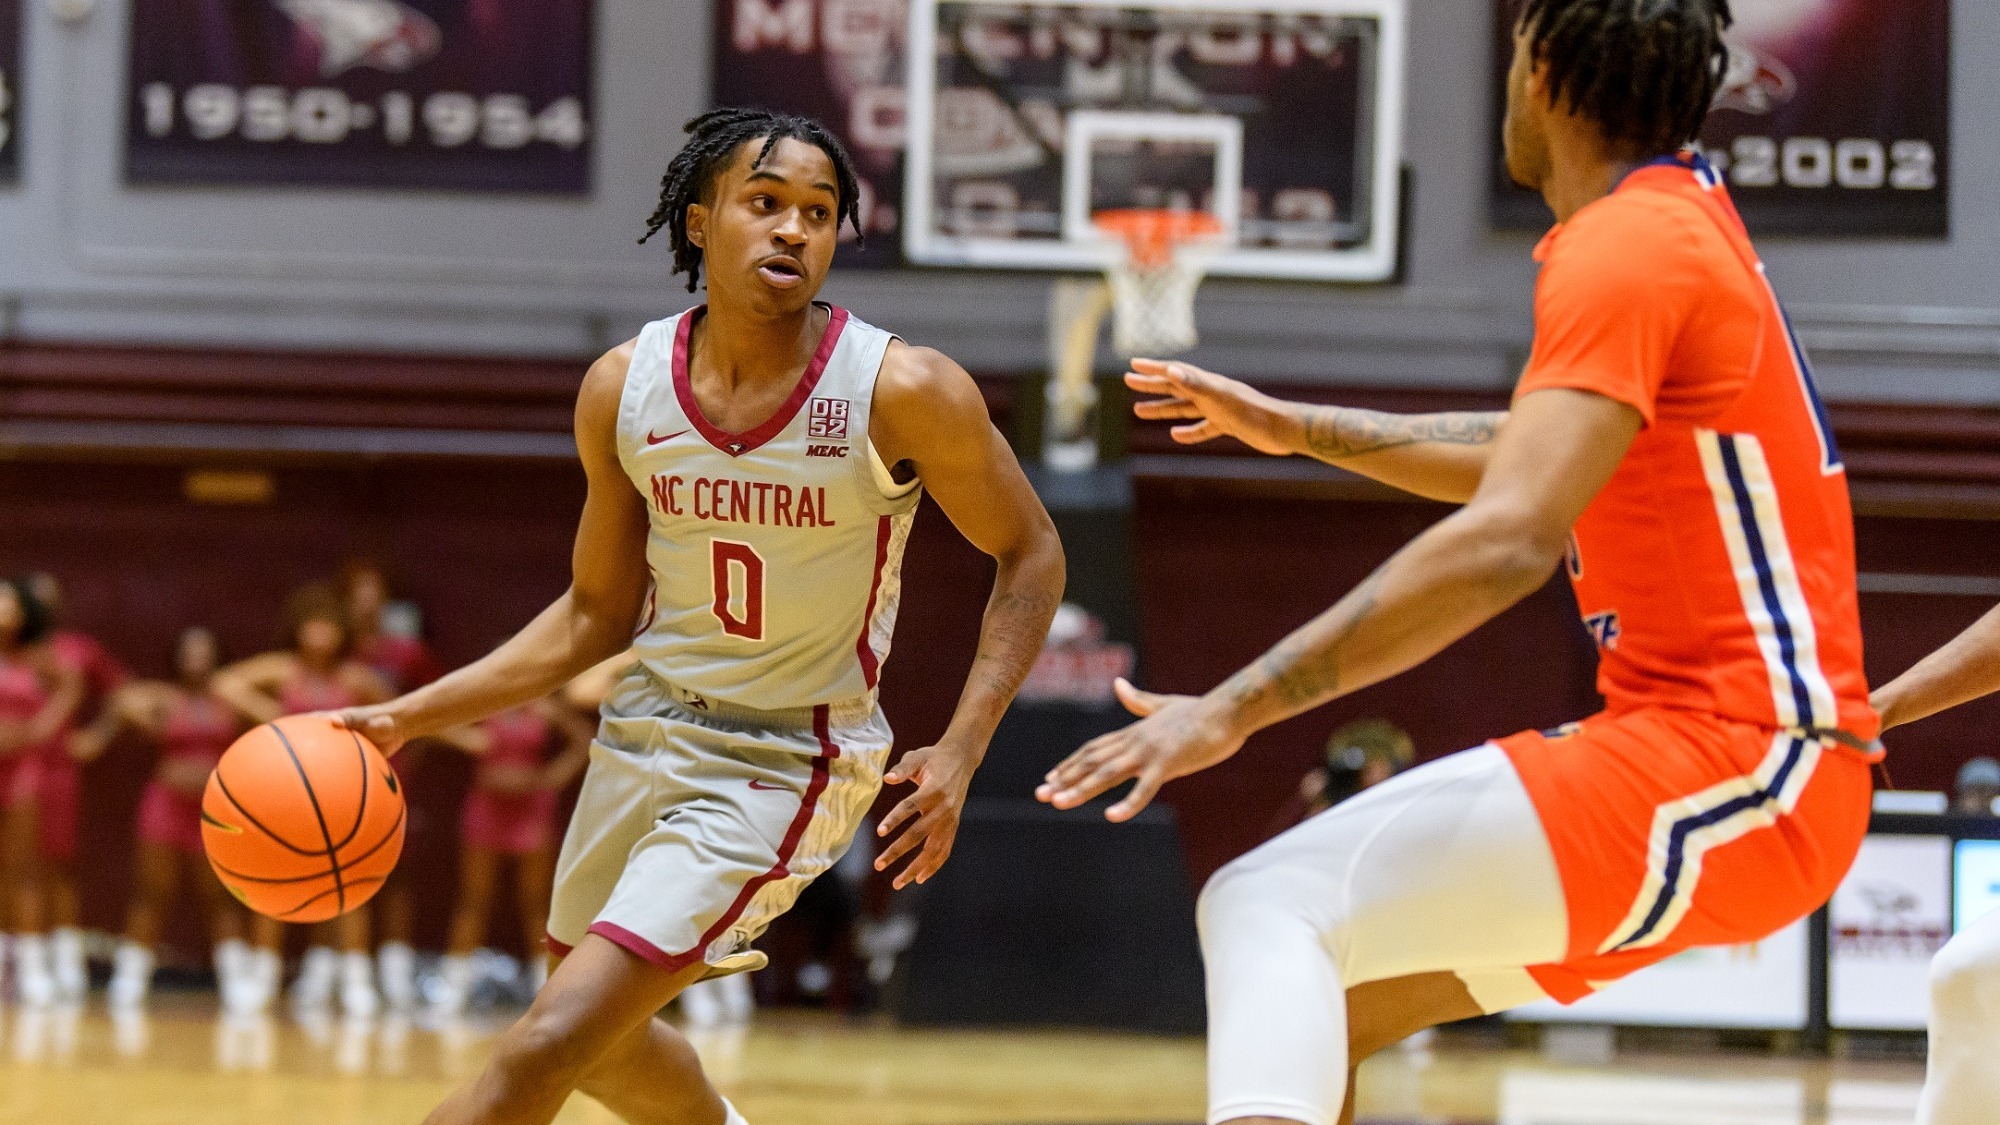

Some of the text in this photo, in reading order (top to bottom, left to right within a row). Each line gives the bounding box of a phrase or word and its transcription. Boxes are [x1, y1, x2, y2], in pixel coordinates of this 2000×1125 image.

[141, 82, 587, 149] 1950-1954
[1702, 133, 1937, 190] -2002
[810, 417, 846, 437] 52
[811, 399, 848, 419] DB
[805, 444, 850, 458] MEAC
[650, 474, 836, 528] NC CENTRAL
[710, 536, 766, 642] 0
